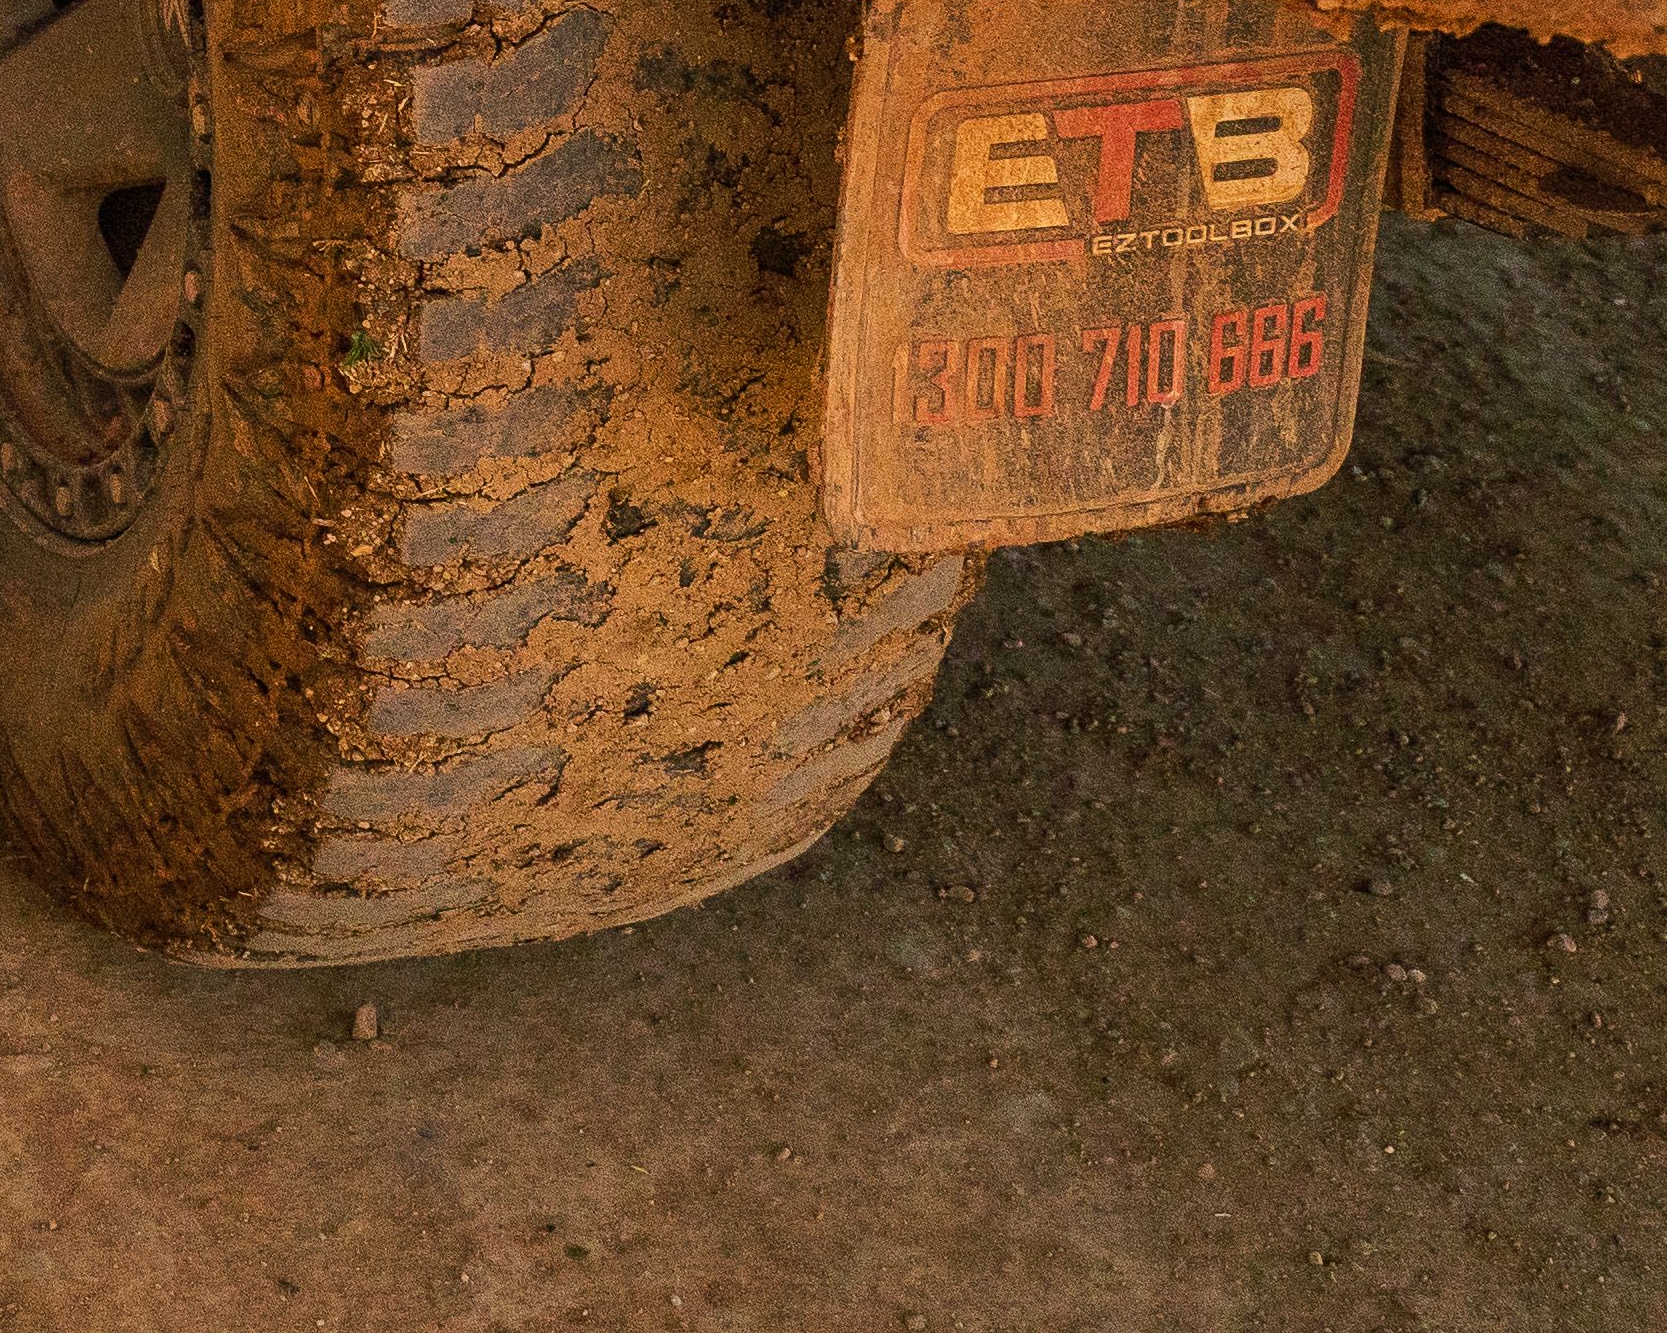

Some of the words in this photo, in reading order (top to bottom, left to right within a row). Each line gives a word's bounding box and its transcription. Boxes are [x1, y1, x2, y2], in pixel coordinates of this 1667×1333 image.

[947, 86, 1315, 236] ETB
[1092, 213, 1302, 256] EZTOOLBOX
[1082, 320, 1186, 413] 710
